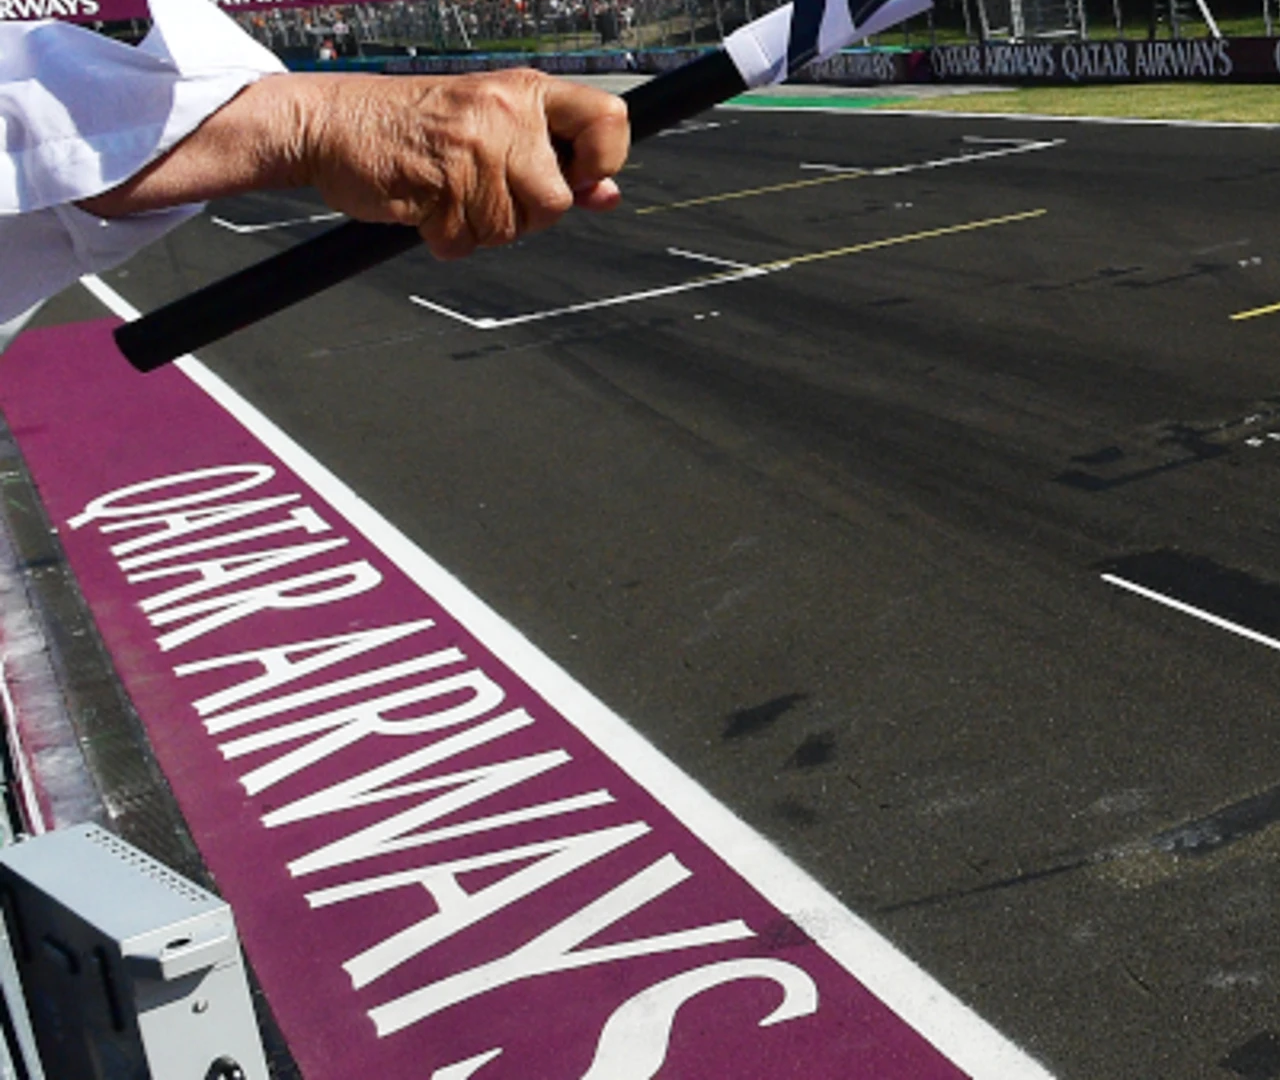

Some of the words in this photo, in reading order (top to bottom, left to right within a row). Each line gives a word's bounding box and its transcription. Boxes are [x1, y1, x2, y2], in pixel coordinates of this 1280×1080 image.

[1061, 42, 1130, 81] QATAR
[1134, 40, 1233, 77] AIRWAYS
[67, 464, 383, 651] QATAR
[172, 618, 819, 1080] AIRWAYS
